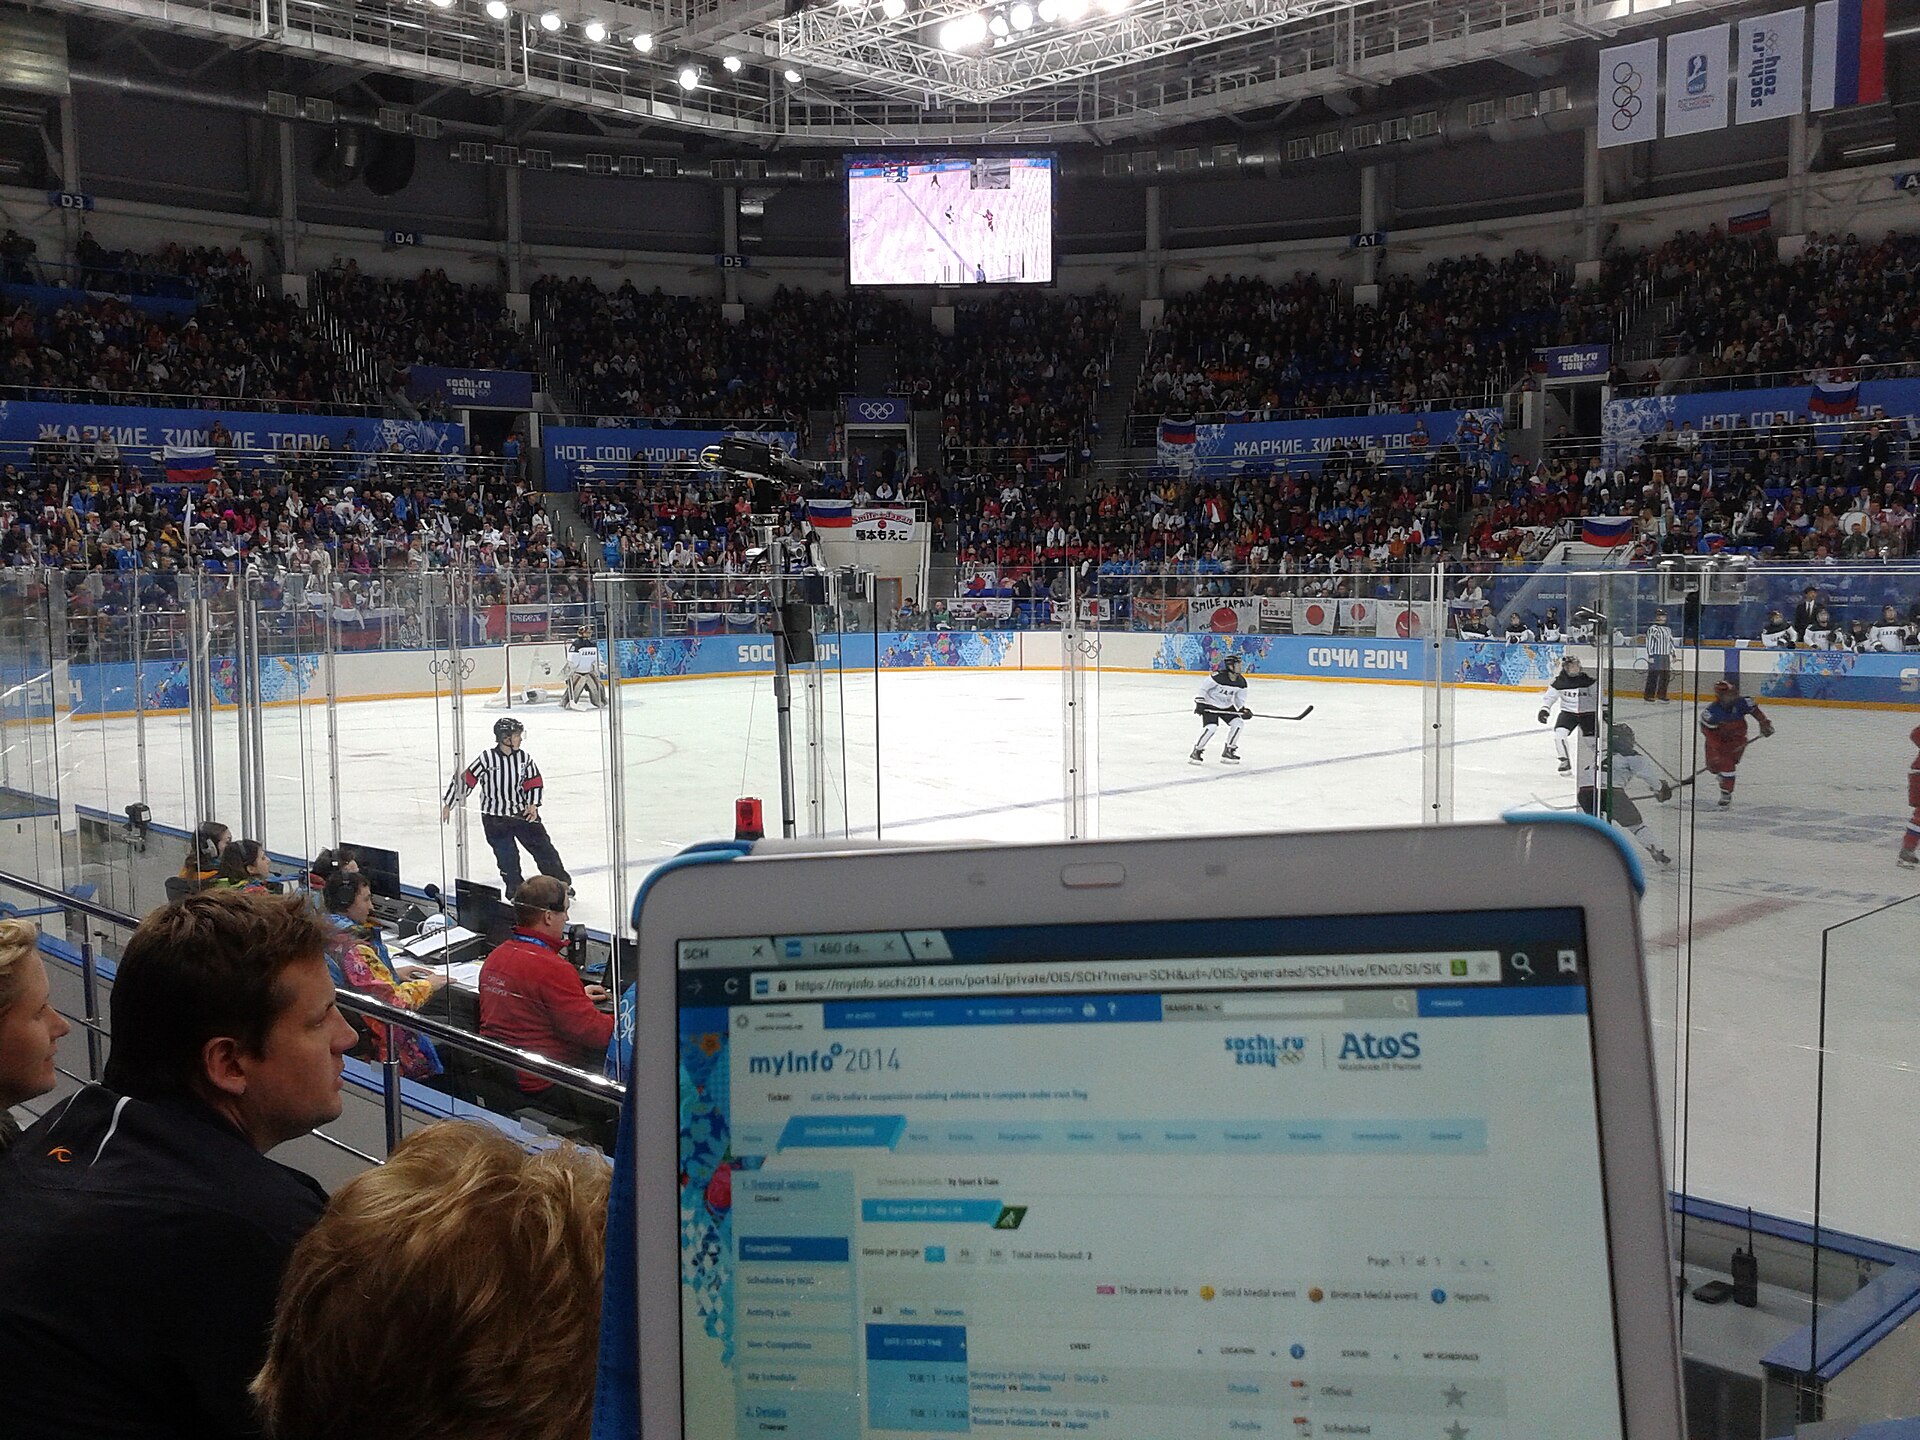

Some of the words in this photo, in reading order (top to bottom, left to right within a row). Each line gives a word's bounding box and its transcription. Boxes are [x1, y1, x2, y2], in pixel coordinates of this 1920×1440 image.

[1749, 31, 1765, 108] sochi.ru
[1764, 55, 1781, 96] 2014
[61, 195, 84, 209] D3
[395, 232, 414, 245] D4
[1358, 235, 1376, 247] A1
[724, 256, 742, 268] D5
[1558, 352, 1598, 364] sochi.ru
[1562, 362, 1583, 371] 2014
[446, 377, 491, 389] sochi.ru
[452, 387, 476, 399] 2014
[1191, 598, 1222, 613] SMILE
[1223, 598, 1253, 609] JAPAN
[738, 644, 775, 663] SOC
[1308, 647, 1359, 668] СОЧИ
[1363, 649, 1408, 670] 2014
[683, 949, 709, 960] SCH
[1225, 1034, 1305, 1051] sochi.ru
[845, 1047, 900, 1072] 2014
[1235, 1050, 1276, 1068] 2014
